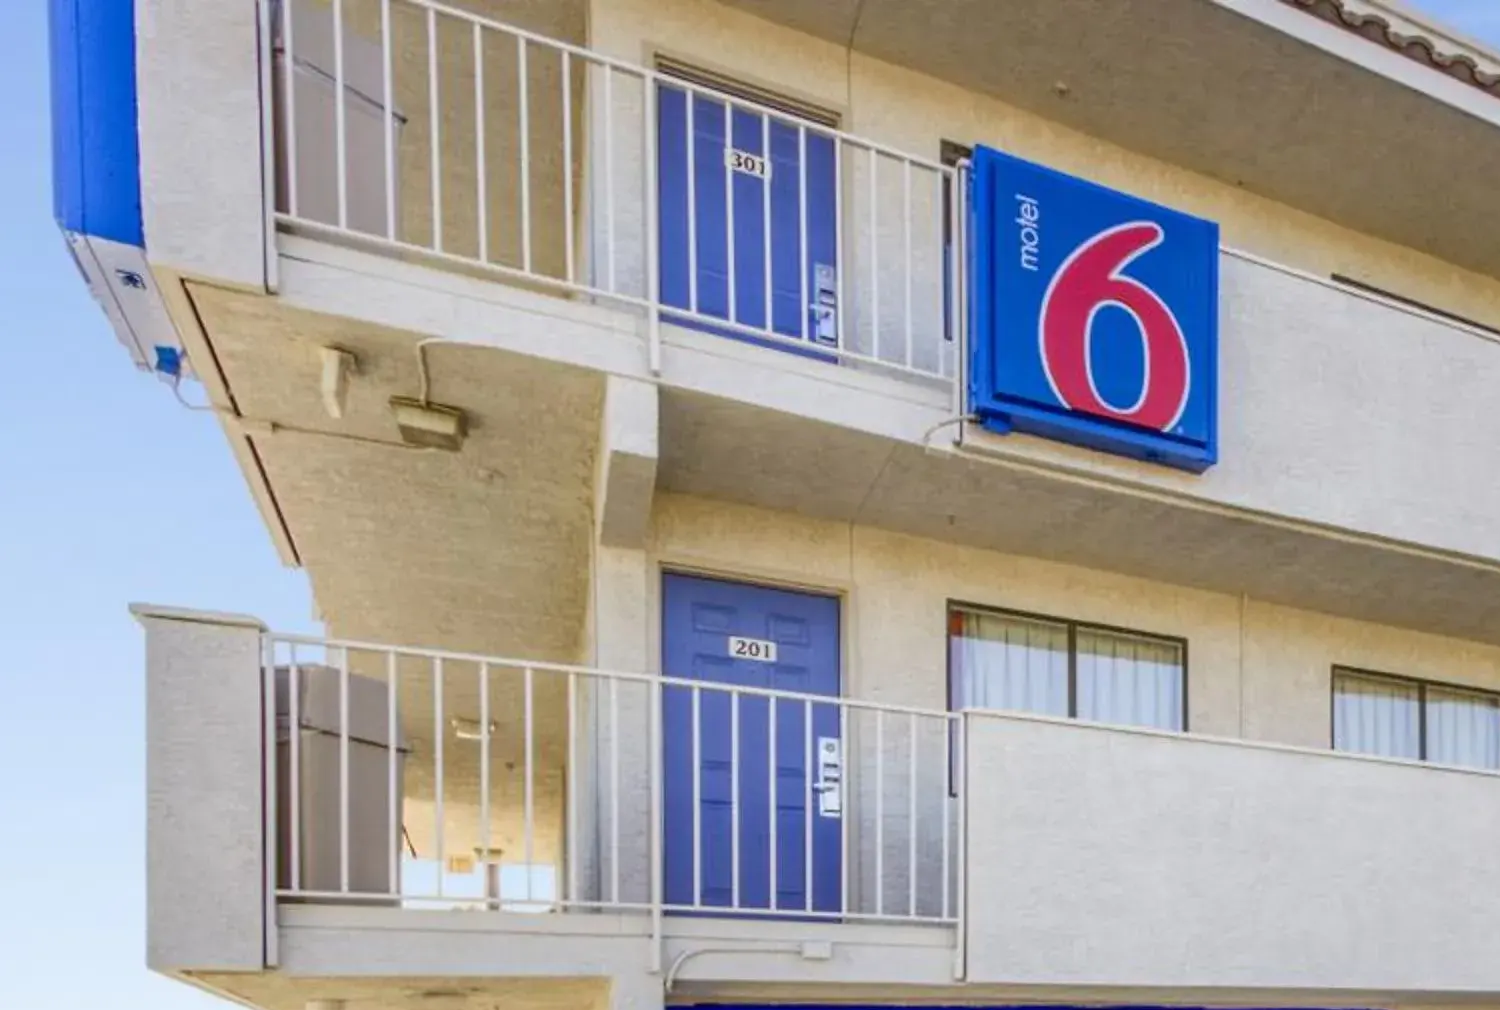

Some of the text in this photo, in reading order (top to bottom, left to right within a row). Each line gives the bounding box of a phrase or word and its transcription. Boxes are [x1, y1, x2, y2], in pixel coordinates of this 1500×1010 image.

[731, 153, 766, 176] 301
[1015, 193, 1191, 432] motel 6
[735, 639, 769, 658] 201
